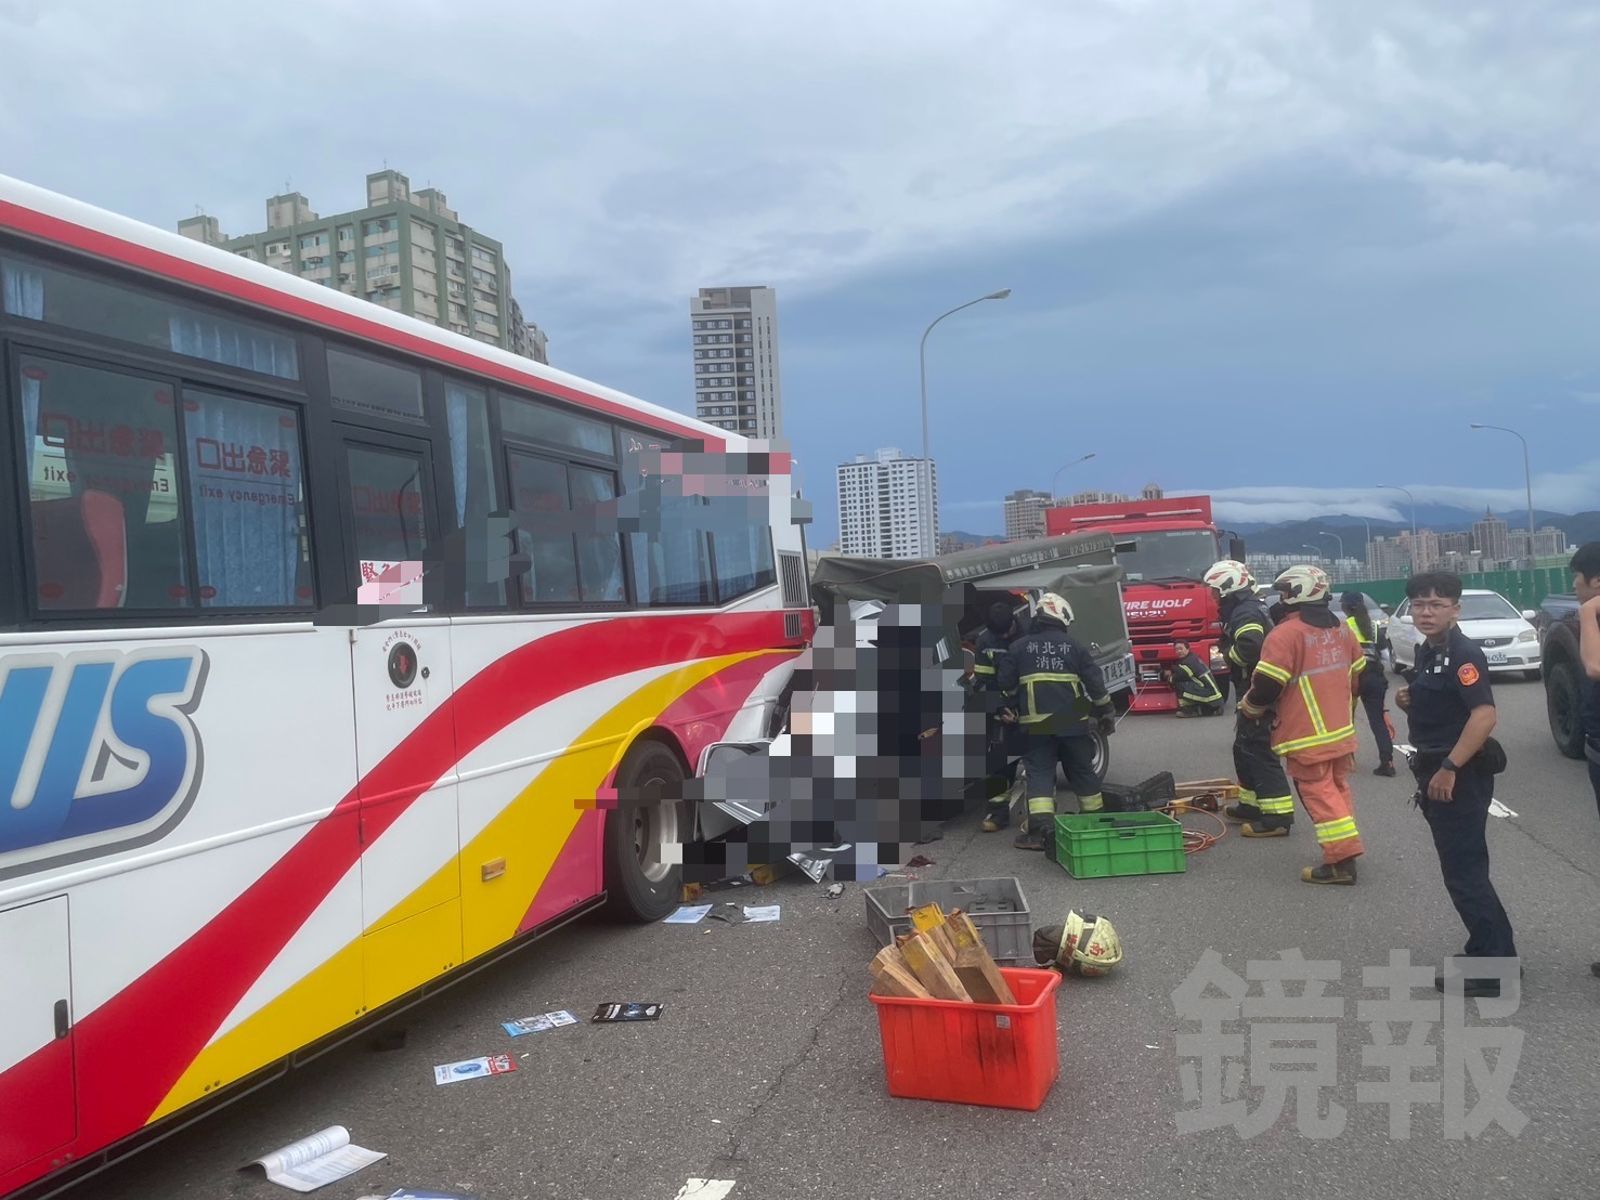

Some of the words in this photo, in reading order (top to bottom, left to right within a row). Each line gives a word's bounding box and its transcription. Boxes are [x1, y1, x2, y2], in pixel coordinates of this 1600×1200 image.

[1152, 598, 1193, 609] WOLF
[1026, 641, 1072, 655] 新北市
[1035, 656, 1065, 671] 消防
